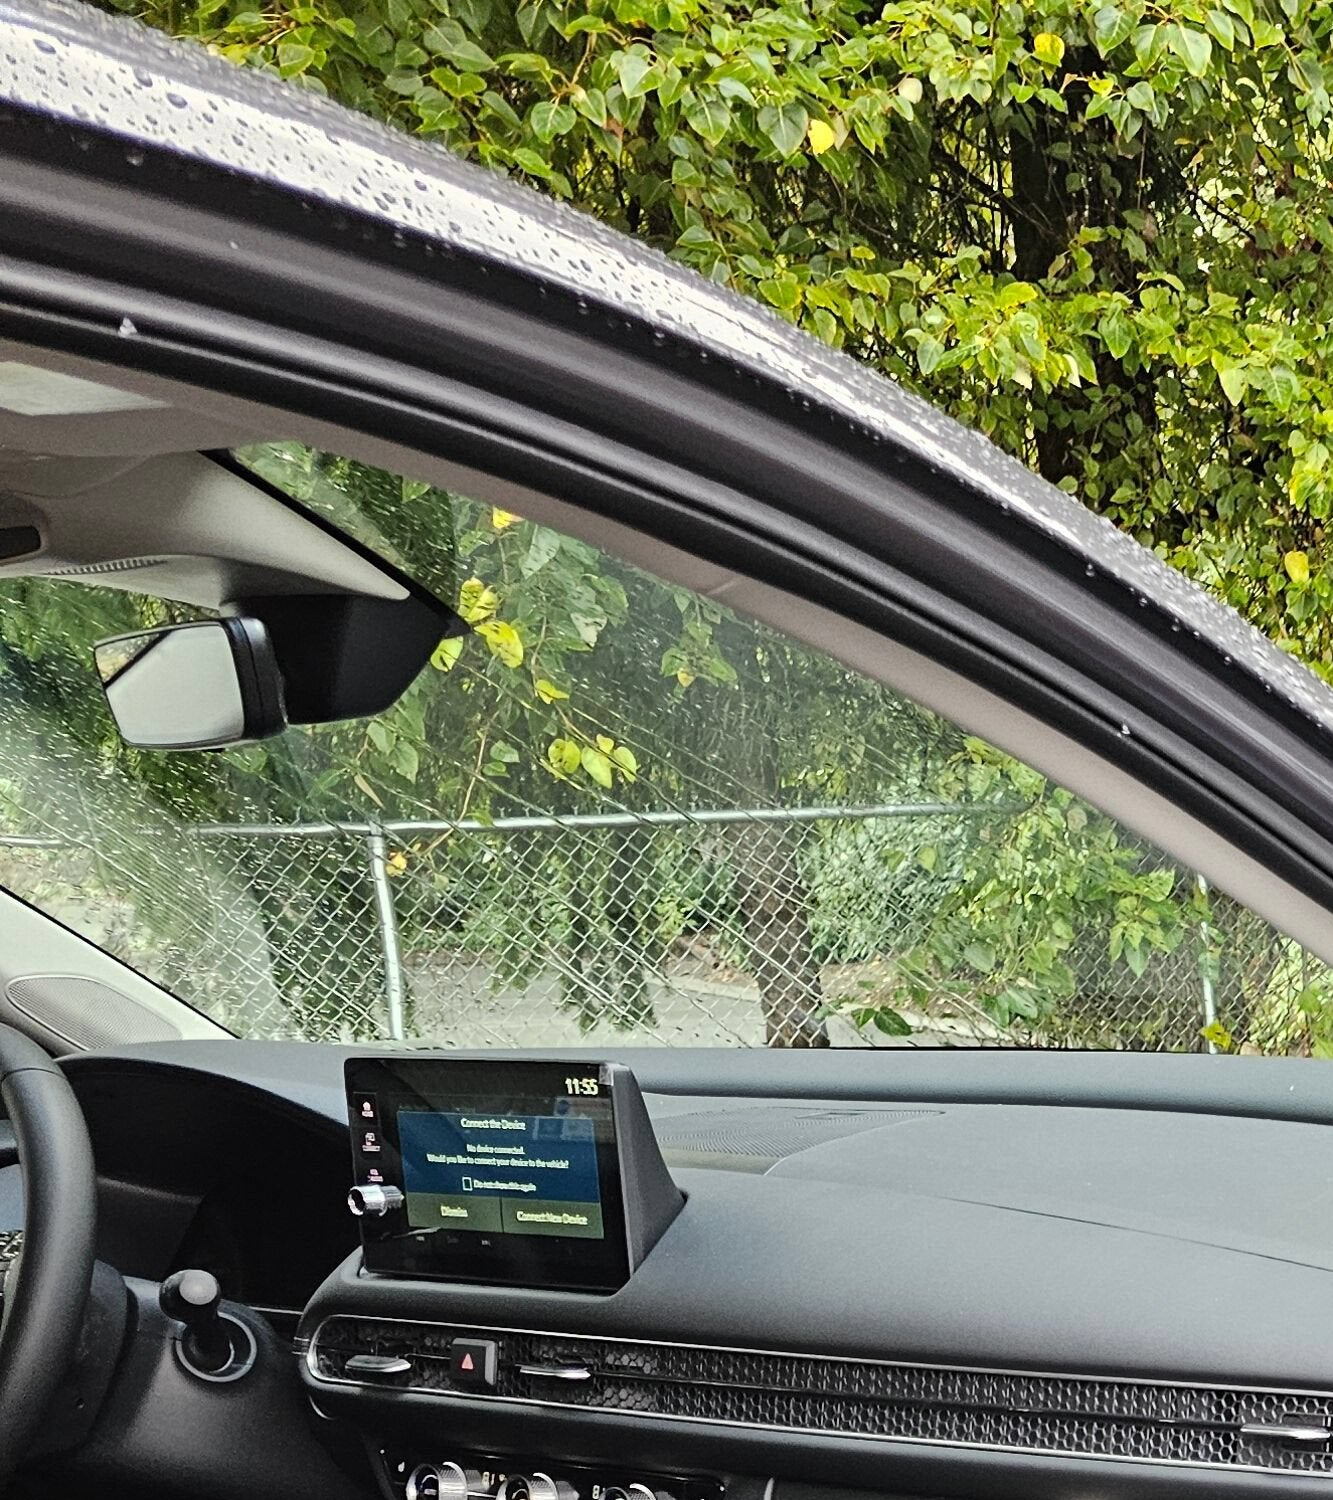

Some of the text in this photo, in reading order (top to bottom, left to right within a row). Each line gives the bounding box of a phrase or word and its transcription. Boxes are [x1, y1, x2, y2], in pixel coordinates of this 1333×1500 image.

[565, 1078, 599, 1096] 11:55
[460, 1118, 489, 1129] Connect
[502, 1121, 526, 1131] Device
